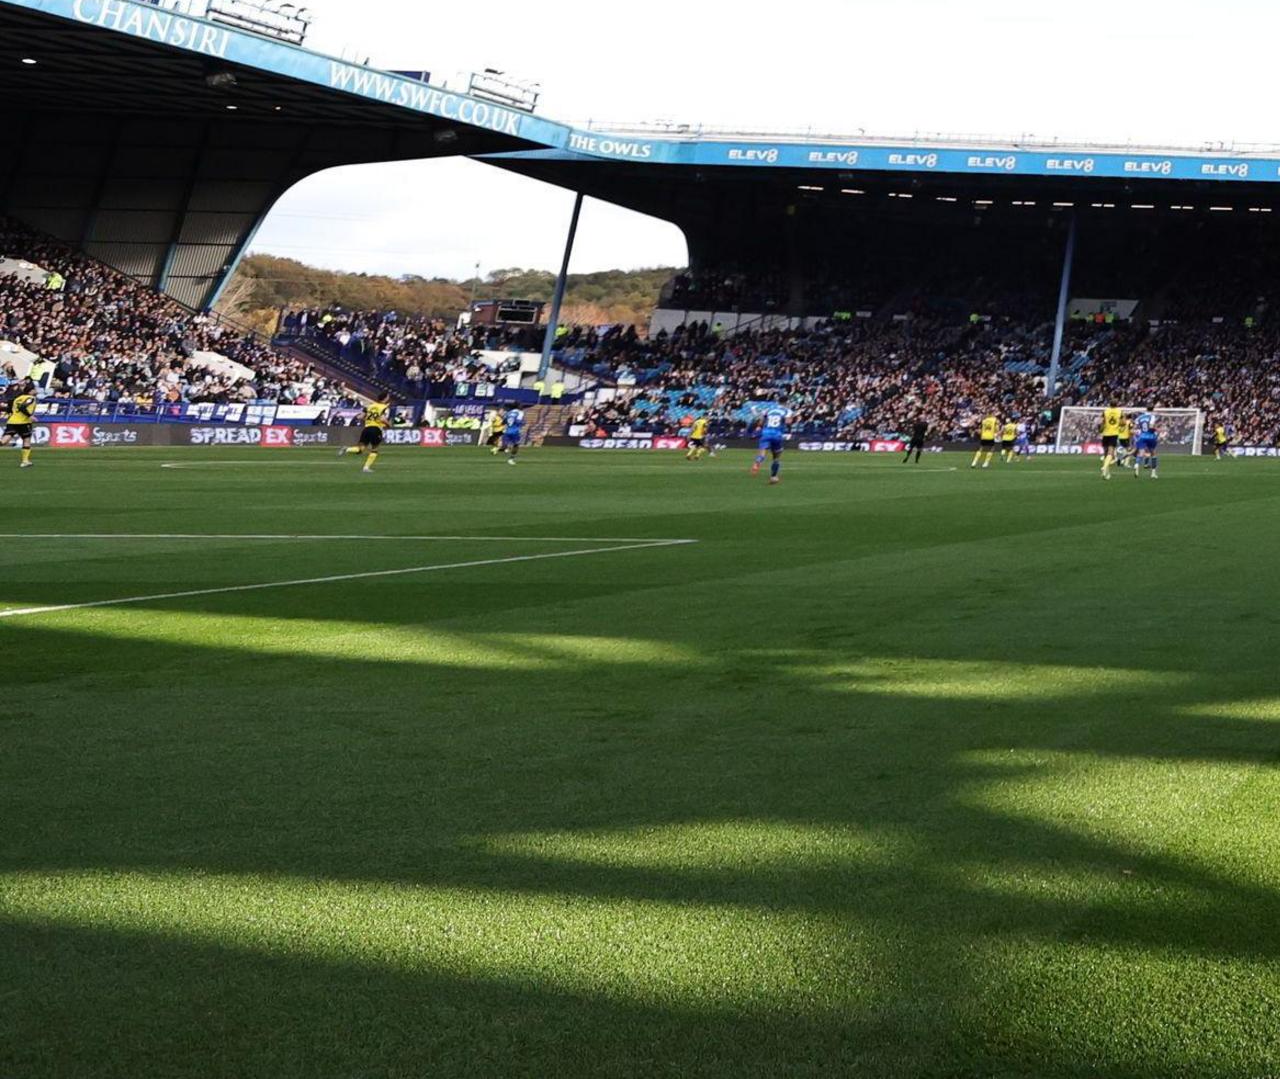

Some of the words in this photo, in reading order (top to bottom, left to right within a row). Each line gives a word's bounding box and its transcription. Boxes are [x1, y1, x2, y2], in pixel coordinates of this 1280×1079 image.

[329, 62, 521, 137] WWW.SWFC.CO.UK
[568, 133, 596, 151] THE
[599, 140, 651, 158] OWLS
[729, 149, 778, 162] ELEV8
[809, 151, 858, 164] ELEV8
[889, 153, 937, 167] ELEV8
[968, 156, 1015, 170] ELEV8
[1047, 158, 1094, 172] ELEV8
[1125, 161, 1171, 174] ELEV8
[1202, 163, 1248, 177] ELEV8
